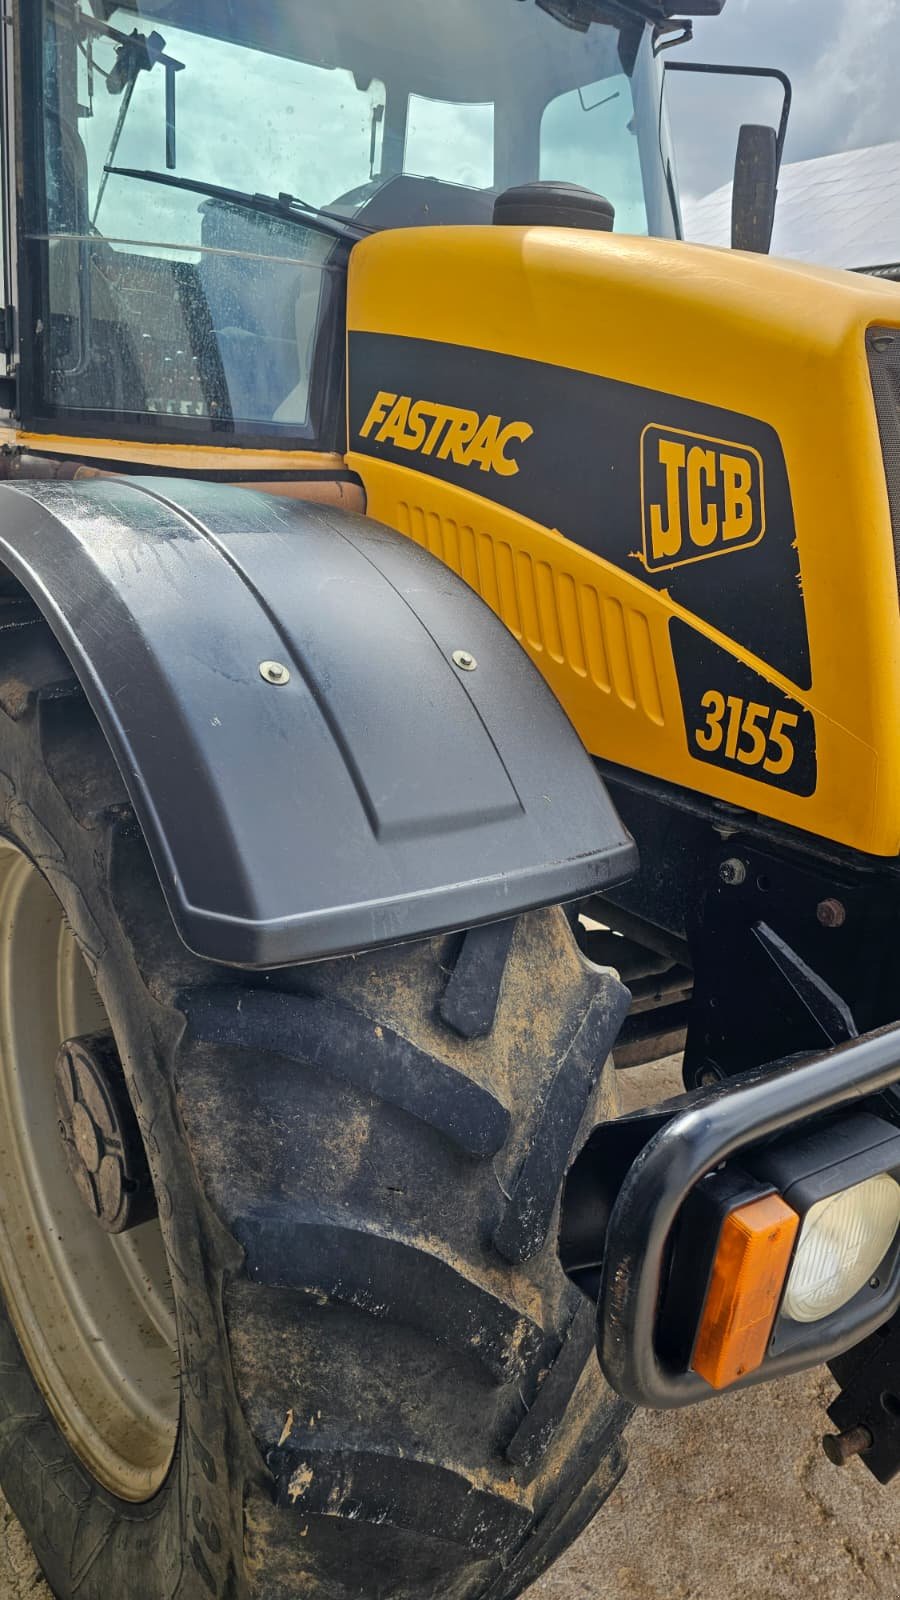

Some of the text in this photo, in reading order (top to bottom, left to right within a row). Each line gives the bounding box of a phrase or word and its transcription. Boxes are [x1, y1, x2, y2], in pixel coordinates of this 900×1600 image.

[358, 391, 534, 476] FASTRAC
[650, 438, 753, 559] JCB
[695, 690, 798, 775] 3155
